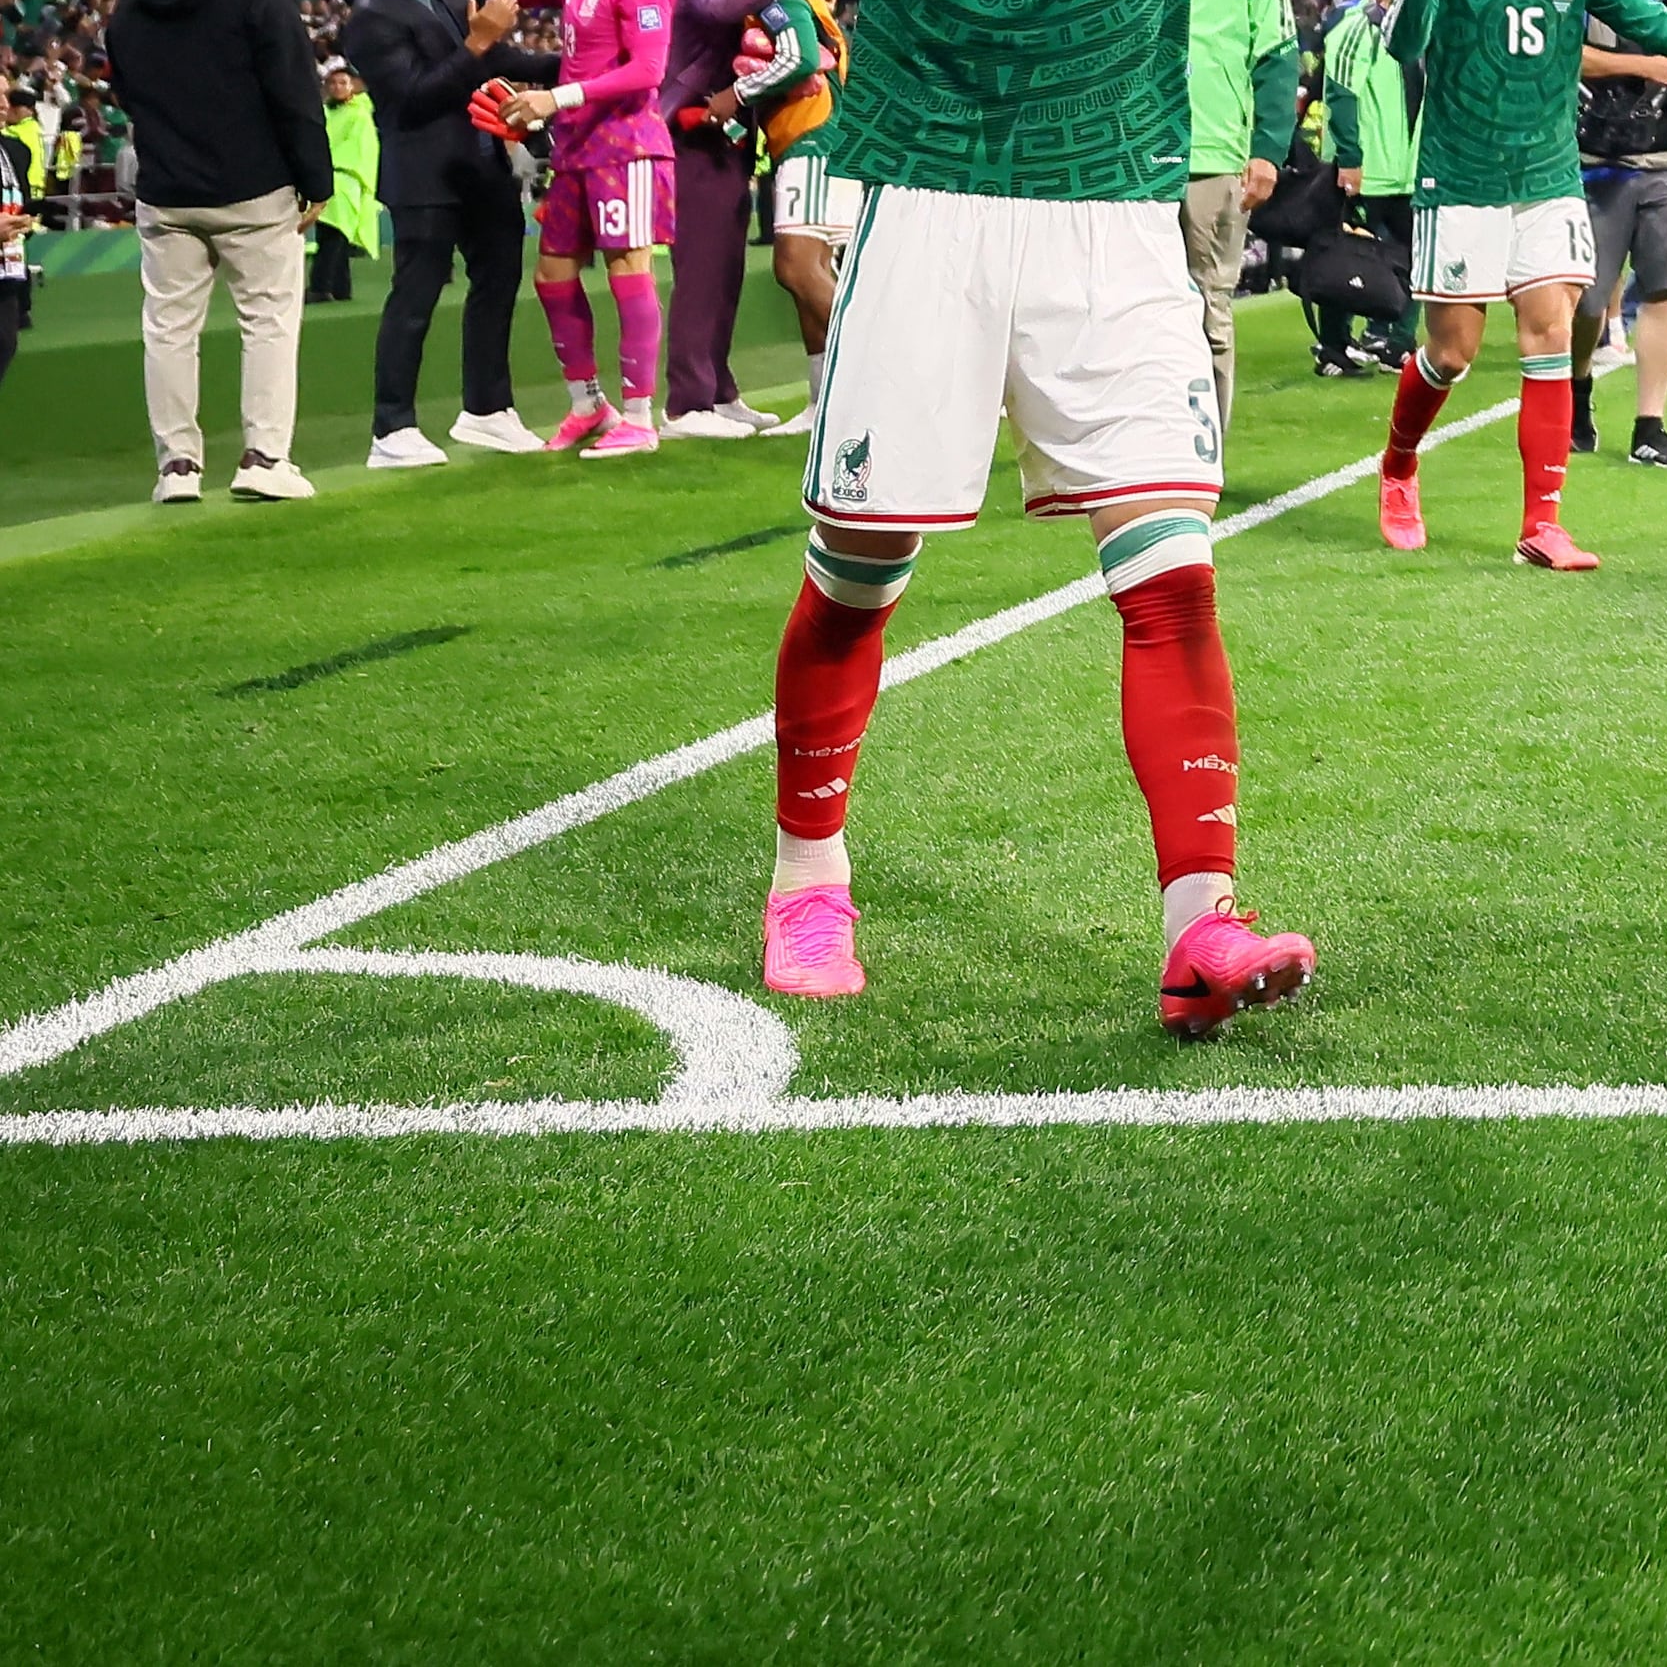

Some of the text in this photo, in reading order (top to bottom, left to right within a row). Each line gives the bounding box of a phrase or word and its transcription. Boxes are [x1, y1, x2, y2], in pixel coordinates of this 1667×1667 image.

[1506, 5, 1545, 57] 15
[597, 198, 627, 237] 13
[785, 186, 801, 218] 7
[1187, 378, 1218, 465] 5
